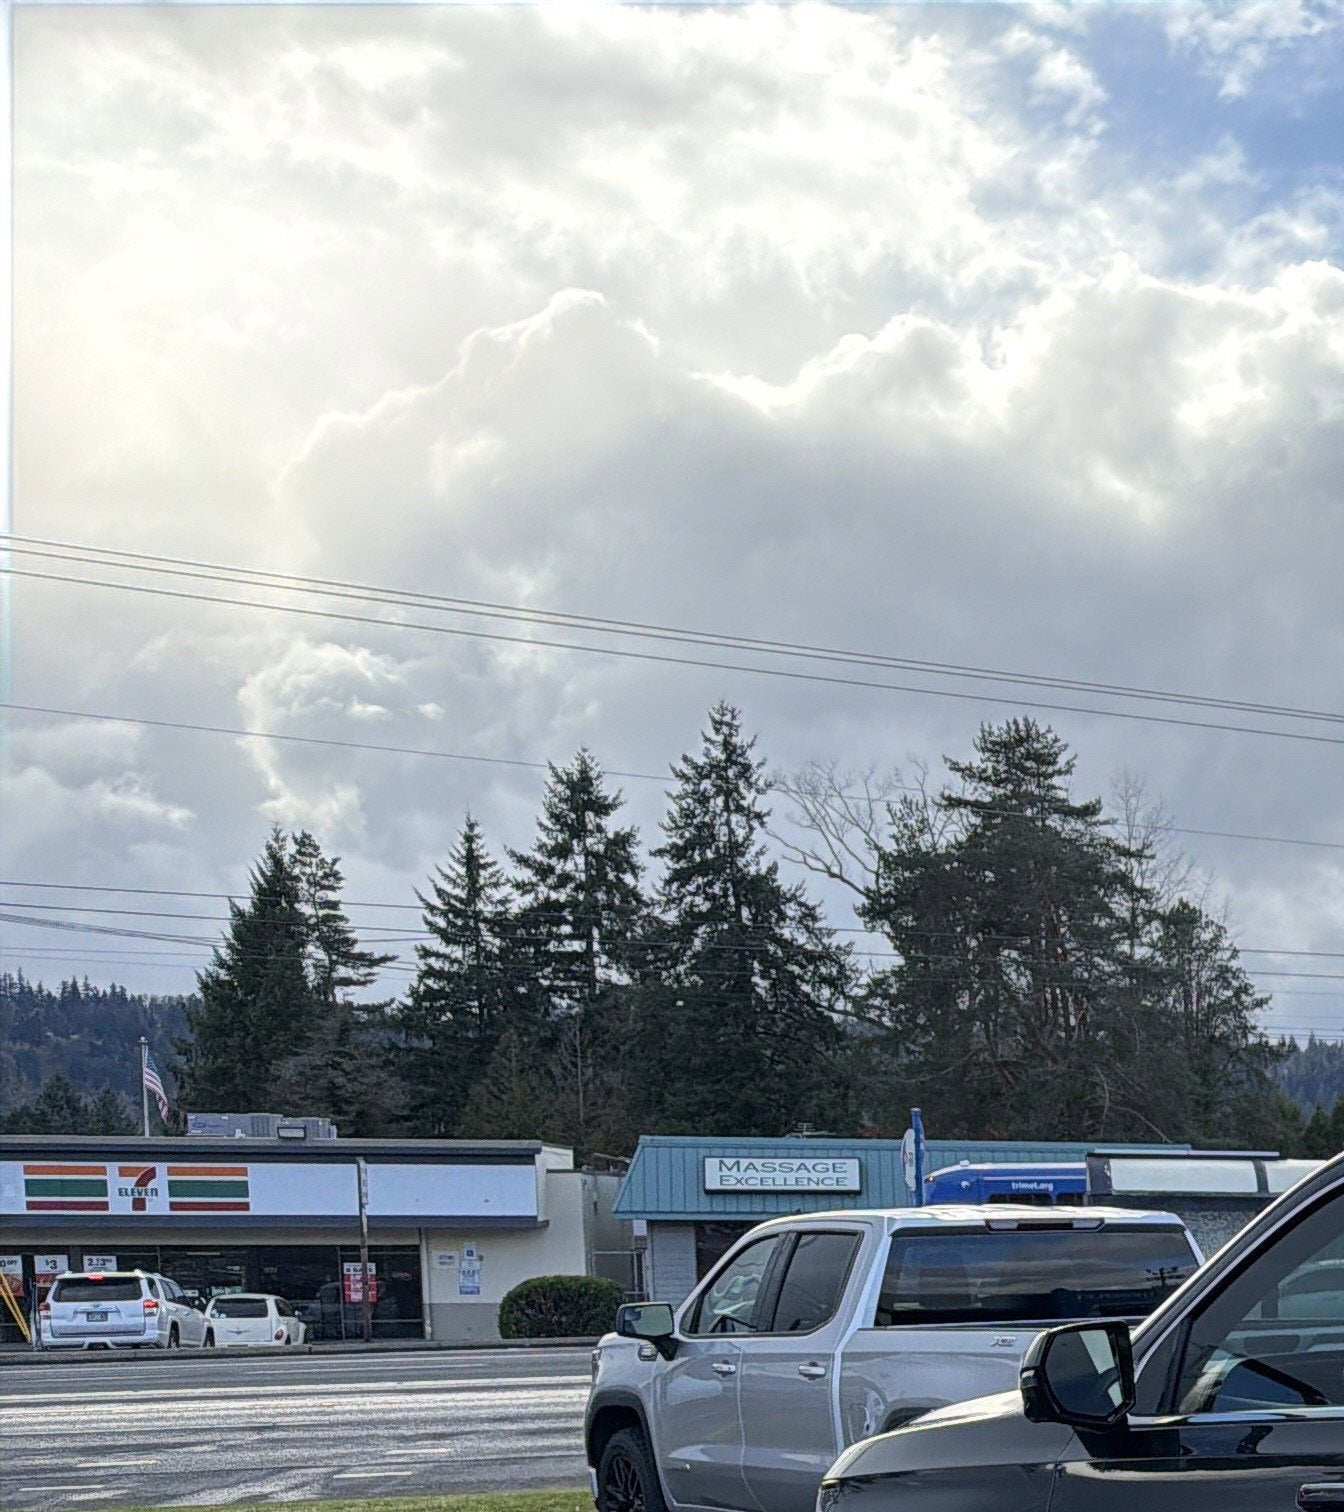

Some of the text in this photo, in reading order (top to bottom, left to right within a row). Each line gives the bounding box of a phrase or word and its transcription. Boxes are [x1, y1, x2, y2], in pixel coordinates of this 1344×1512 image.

[718, 1159, 848, 1174] MASSAGE
[719, 1174, 848, 1187] EXCELLENCE
[1011, 1181, 1054, 1192] trimet.org
